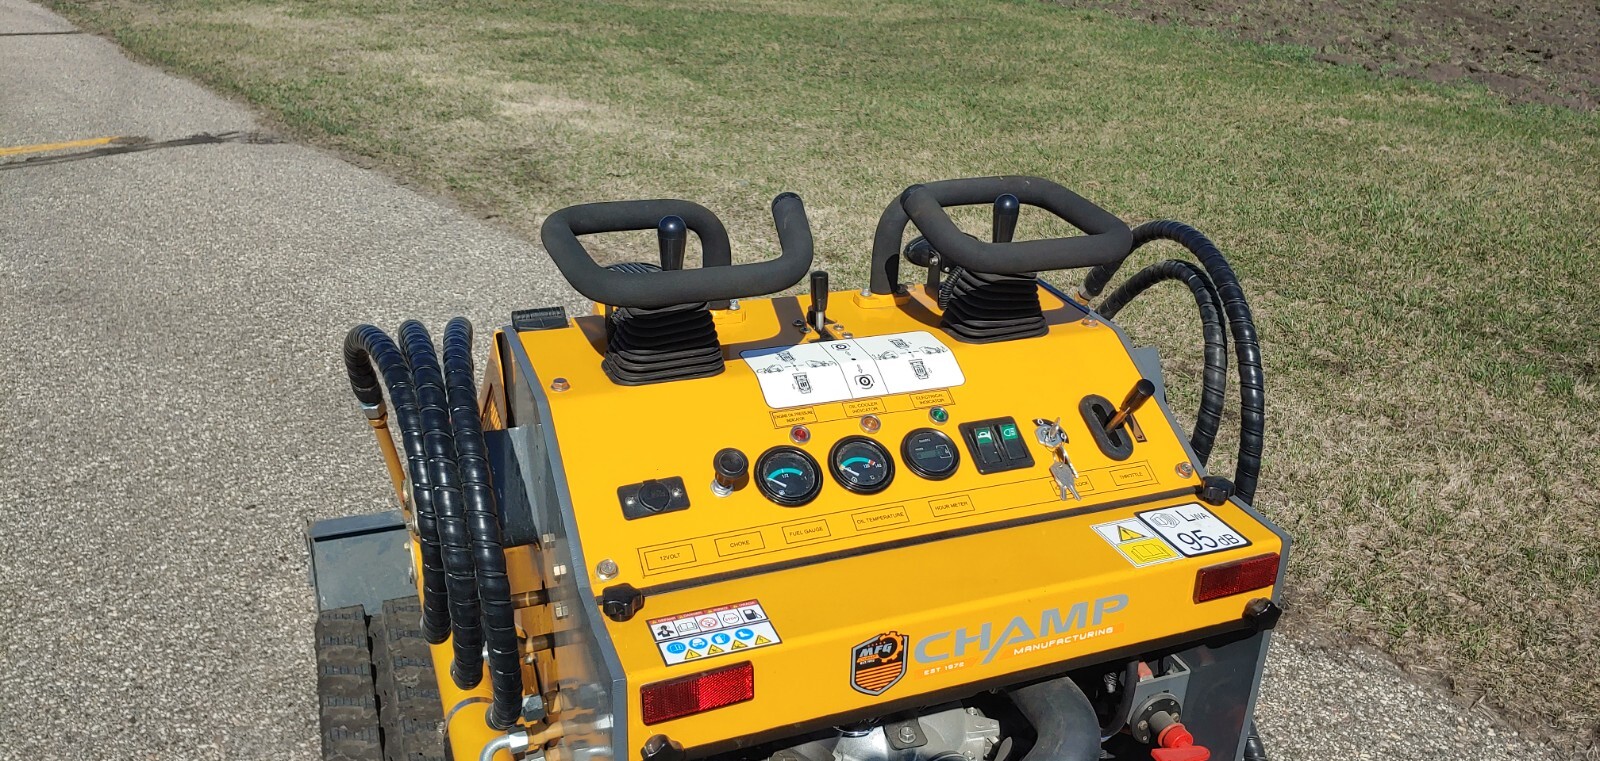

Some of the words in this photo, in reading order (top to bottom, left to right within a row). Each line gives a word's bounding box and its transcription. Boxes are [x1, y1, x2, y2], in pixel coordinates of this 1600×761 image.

[1119, 471, 1143, 480] THROTTLE
[935, 503, 950, 511] HOUR
[951, 501, 968, 509] METER
[866, 511, 904, 523] TEMPERATURE
[789, 529, 803, 537] FUEL
[804, 526, 824, 535] GAUGE
[729, 540, 750, 548] CHOKE
[1176, 529, 1218, 551] 95
[1217, 533, 1240, 547] dB
[659, 552, 681, 561] 12VOLT
[914, 593, 1129, 666] CHAMP
[1013, 626, 1114, 656] MANUFACTURING
[859, 643, 893, 658] MFG
[923, 665, 942, 676] EST
[944, 661, 965, 672] 1972
